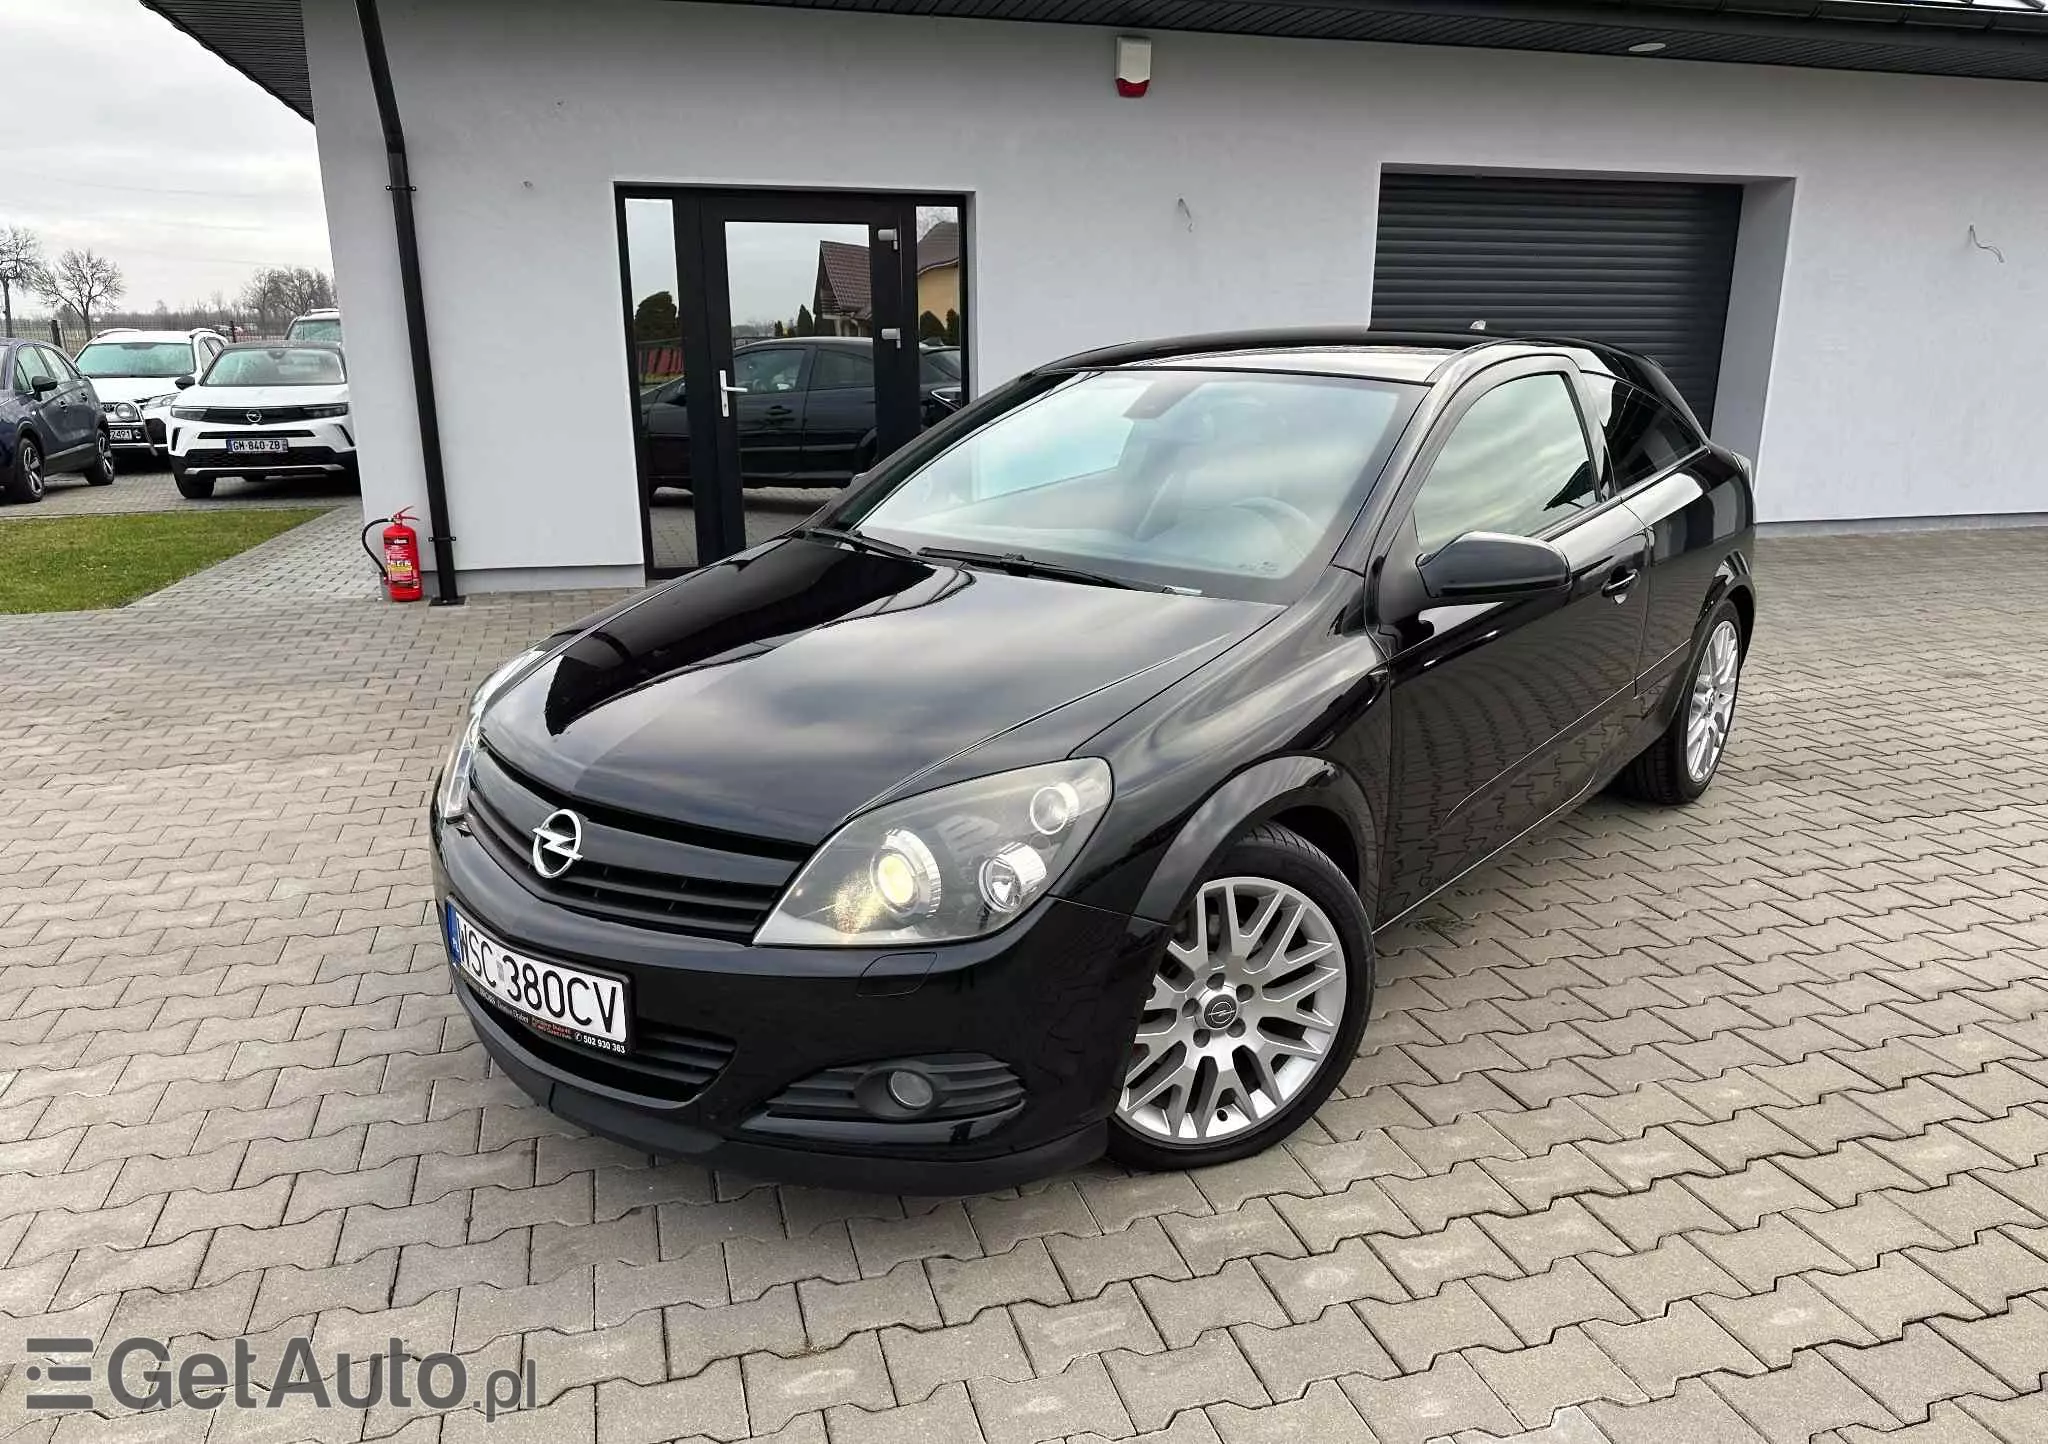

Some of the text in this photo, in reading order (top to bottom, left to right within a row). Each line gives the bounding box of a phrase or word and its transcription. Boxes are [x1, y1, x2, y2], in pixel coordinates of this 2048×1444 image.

[502, 954, 617, 1033] 380CV
[583, 1034, 596, 1046] 502
[597, 1038, 611, 1050] 930
